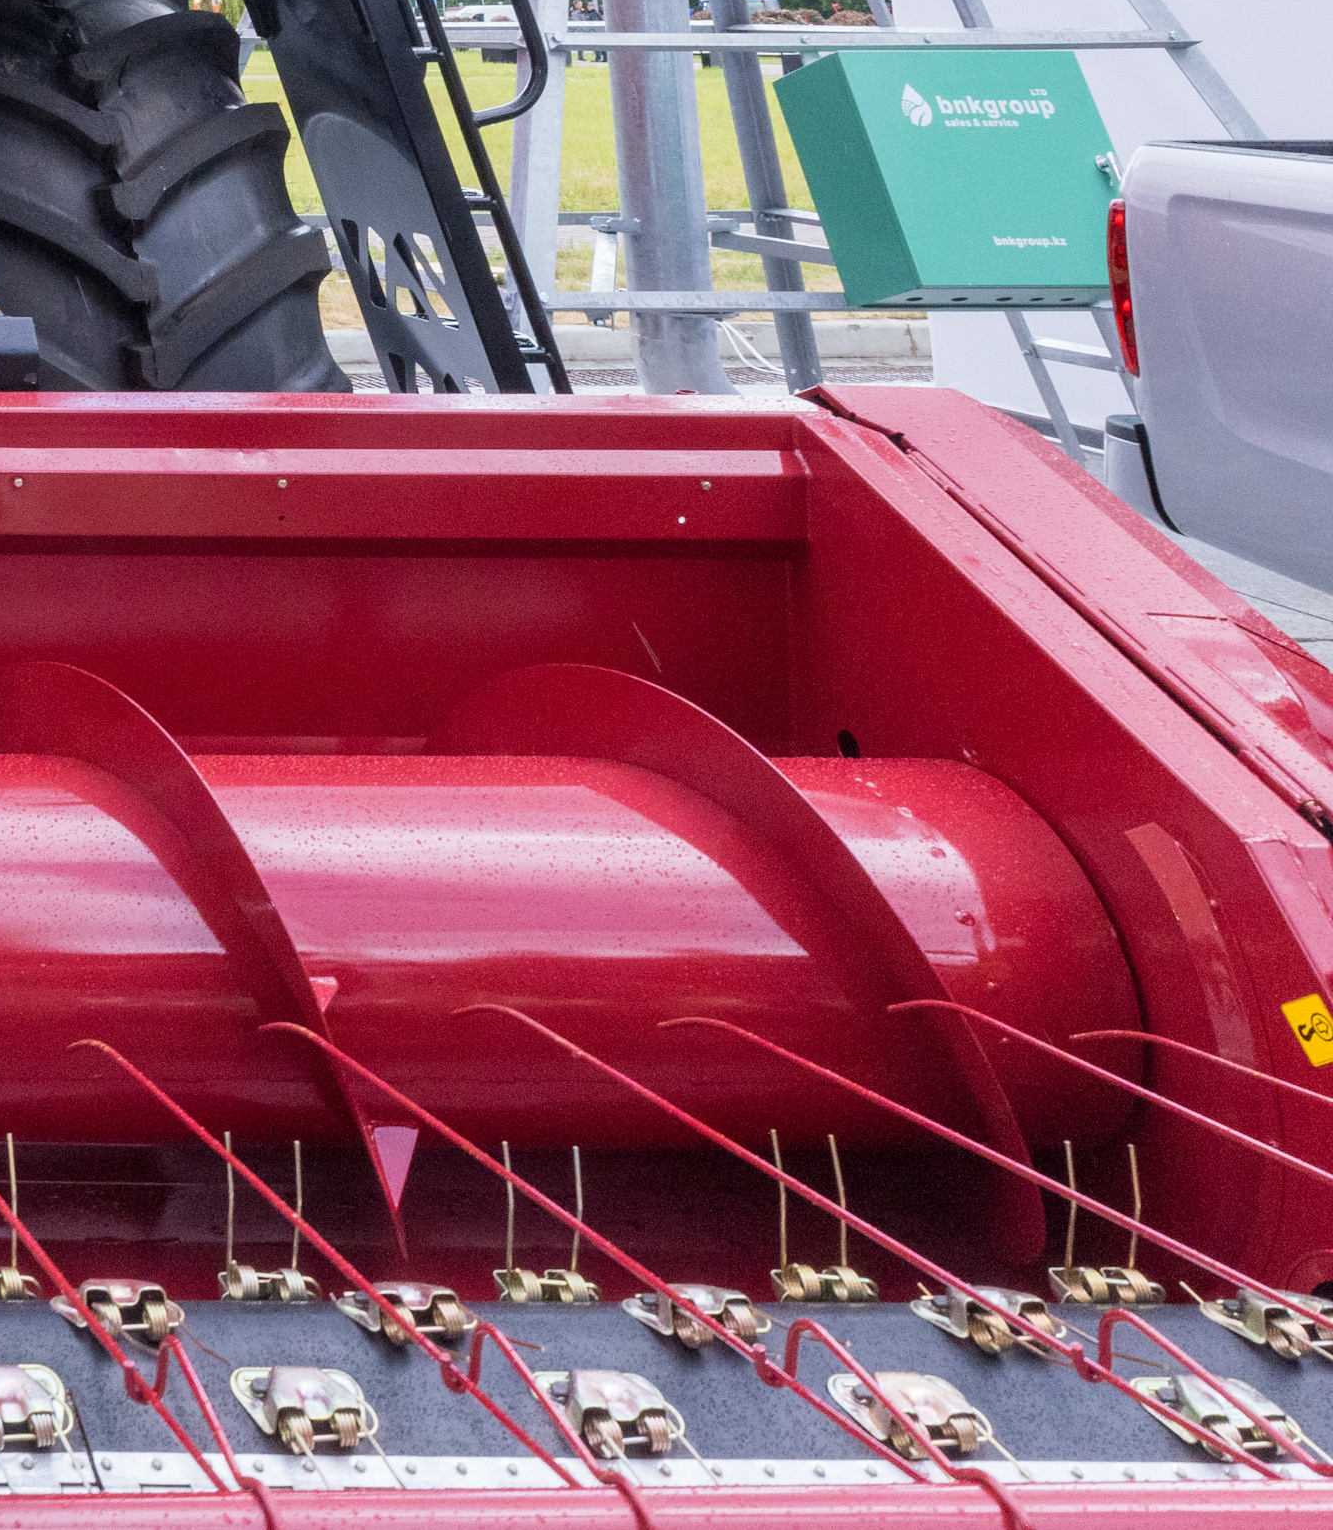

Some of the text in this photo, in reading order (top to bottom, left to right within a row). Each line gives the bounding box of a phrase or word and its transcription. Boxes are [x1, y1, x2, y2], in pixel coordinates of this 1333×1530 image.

[1029, 88, 1048, 97] LTD
[935, 95, 1055, 120] bnkgroup
[944, 118, 1019, 127] sales & service
[993, 236, 1068, 248] bnkgroup.kz
